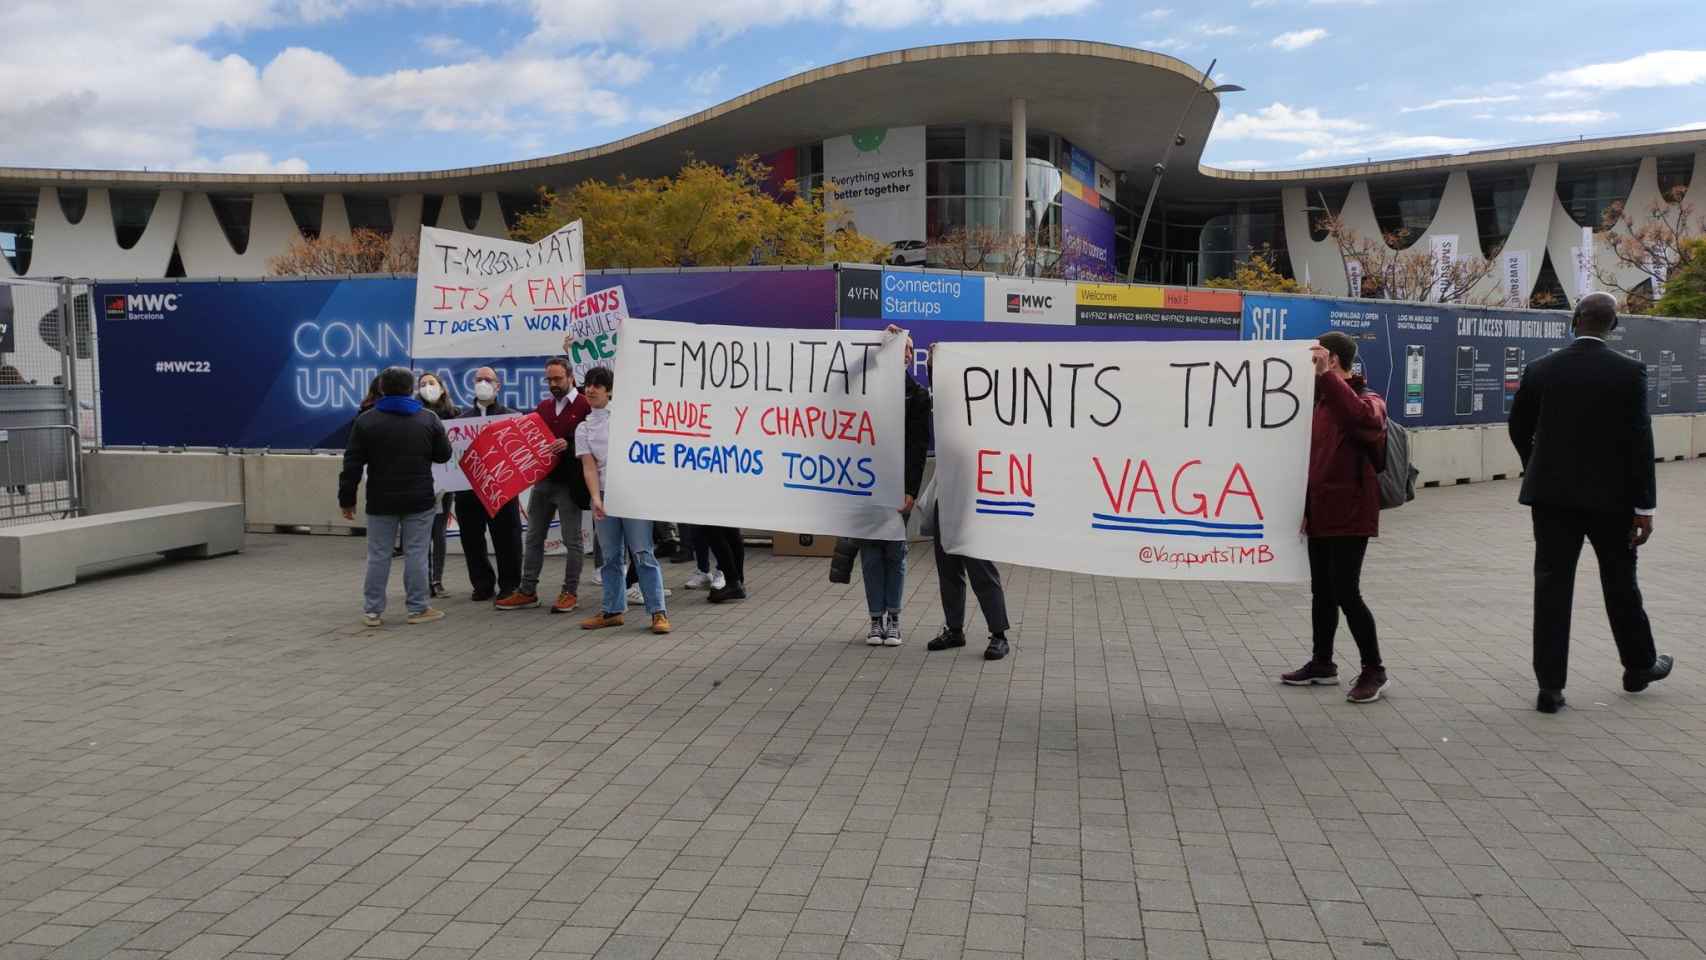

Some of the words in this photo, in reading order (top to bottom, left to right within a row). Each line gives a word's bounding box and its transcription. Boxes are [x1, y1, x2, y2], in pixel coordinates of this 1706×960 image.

[832, 171, 880, 186] Everything
[881, 167, 914, 180] works
[833, 188, 862, 200] better
[864, 182, 911, 198] together
[435, 228, 577, 277] T-MOBILITAT
[499, 284, 517, 306] A
[847, 287, 879, 300] 4YFN
[884, 274, 960, 298] Connecting
[1081, 289, 1117, 302] Welcome
[127, 294, 178, 311] MWC
[569, 290, 620, 324] MENYS
[884, 296, 941, 316] Startups
[1022, 294, 1052, 308] MWC
[128, 312, 164, 320] Barcelona
[424, 319, 448, 335] IT
[451, 314, 513, 334] DOESN'T
[1479, 318, 1503, 337] ACCESS
[156, 361, 211, 373] #MWC22
[638, 339, 882, 395] T-MOBILITAT
[963, 361, 1122, 429] PUNTS
[1169, 357, 1300, 429] TMB
[639, 398, 712, 430] FRAUDE
[735, 406, 748, 435] Y
[760, 406, 876, 446] CHAPUZA
[481, 445, 498, 461] Y
[490, 459, 514, 483] NO
[628, 440, 666, 465] QUE
[674, 443, 764, 475] PAGAMOS
[782, 452, 876, 489] TODXS
[977, 449, 1033, 498] EN
[1092, 456, 1264, 520] VAGA
